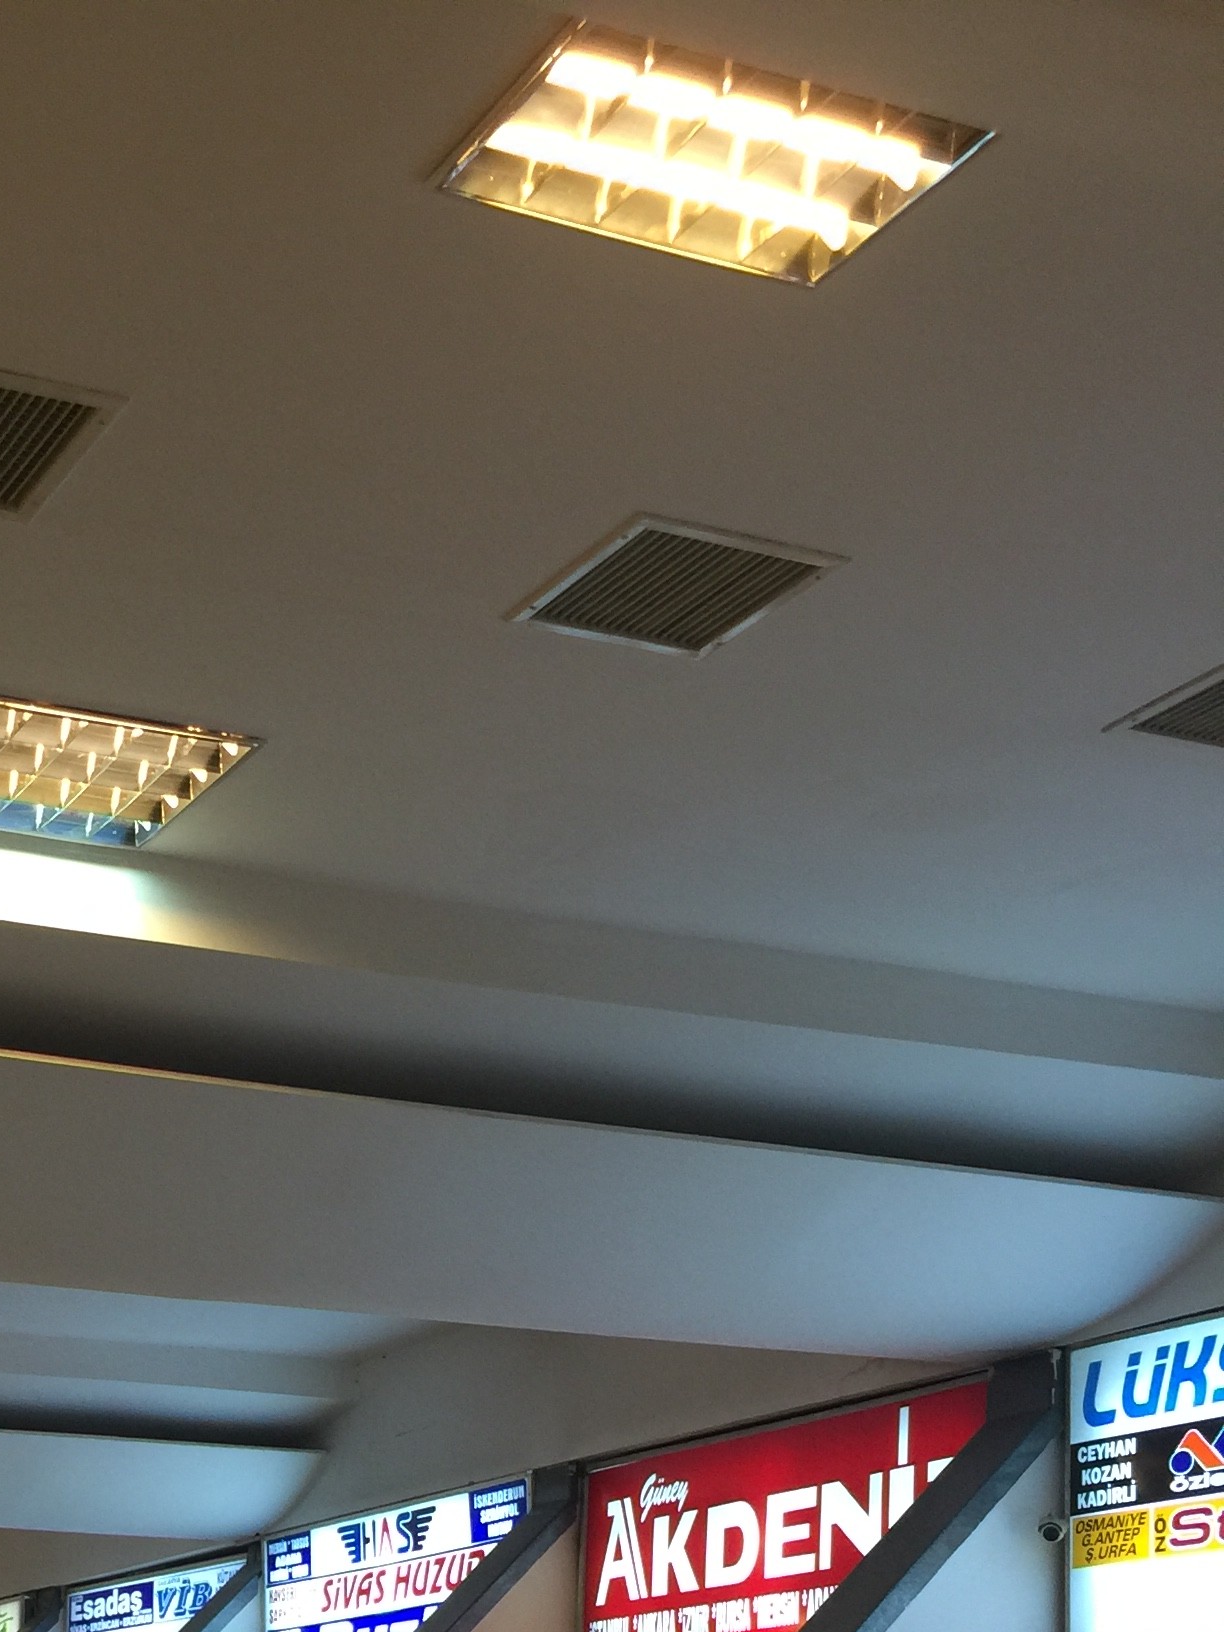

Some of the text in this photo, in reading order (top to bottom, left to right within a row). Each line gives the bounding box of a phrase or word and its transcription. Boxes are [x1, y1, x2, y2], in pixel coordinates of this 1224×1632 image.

[1081, 1333, 1224, 1428] LÜK
[1077, 1437, 1137, 1464] CEYHAN
[1081, 1462, 1132, 1486] KOZAN
[473, 1485, 525, 1509] İSKENDERUN
[640, 1473, 689, 1524] Güney
[1077, 1480, 1137, 1510] KADİRLİ
[1075, 1512, 1148, 1534] OSMANİYE
[1081, 1527, 1141, 1547] G.ANTEP
[1084, 1544, 1138, 1564] Ş.URFA
[70, 1588, 143, 1622] Esadaş
[320, 1570, 387, 1613] SİVAS
